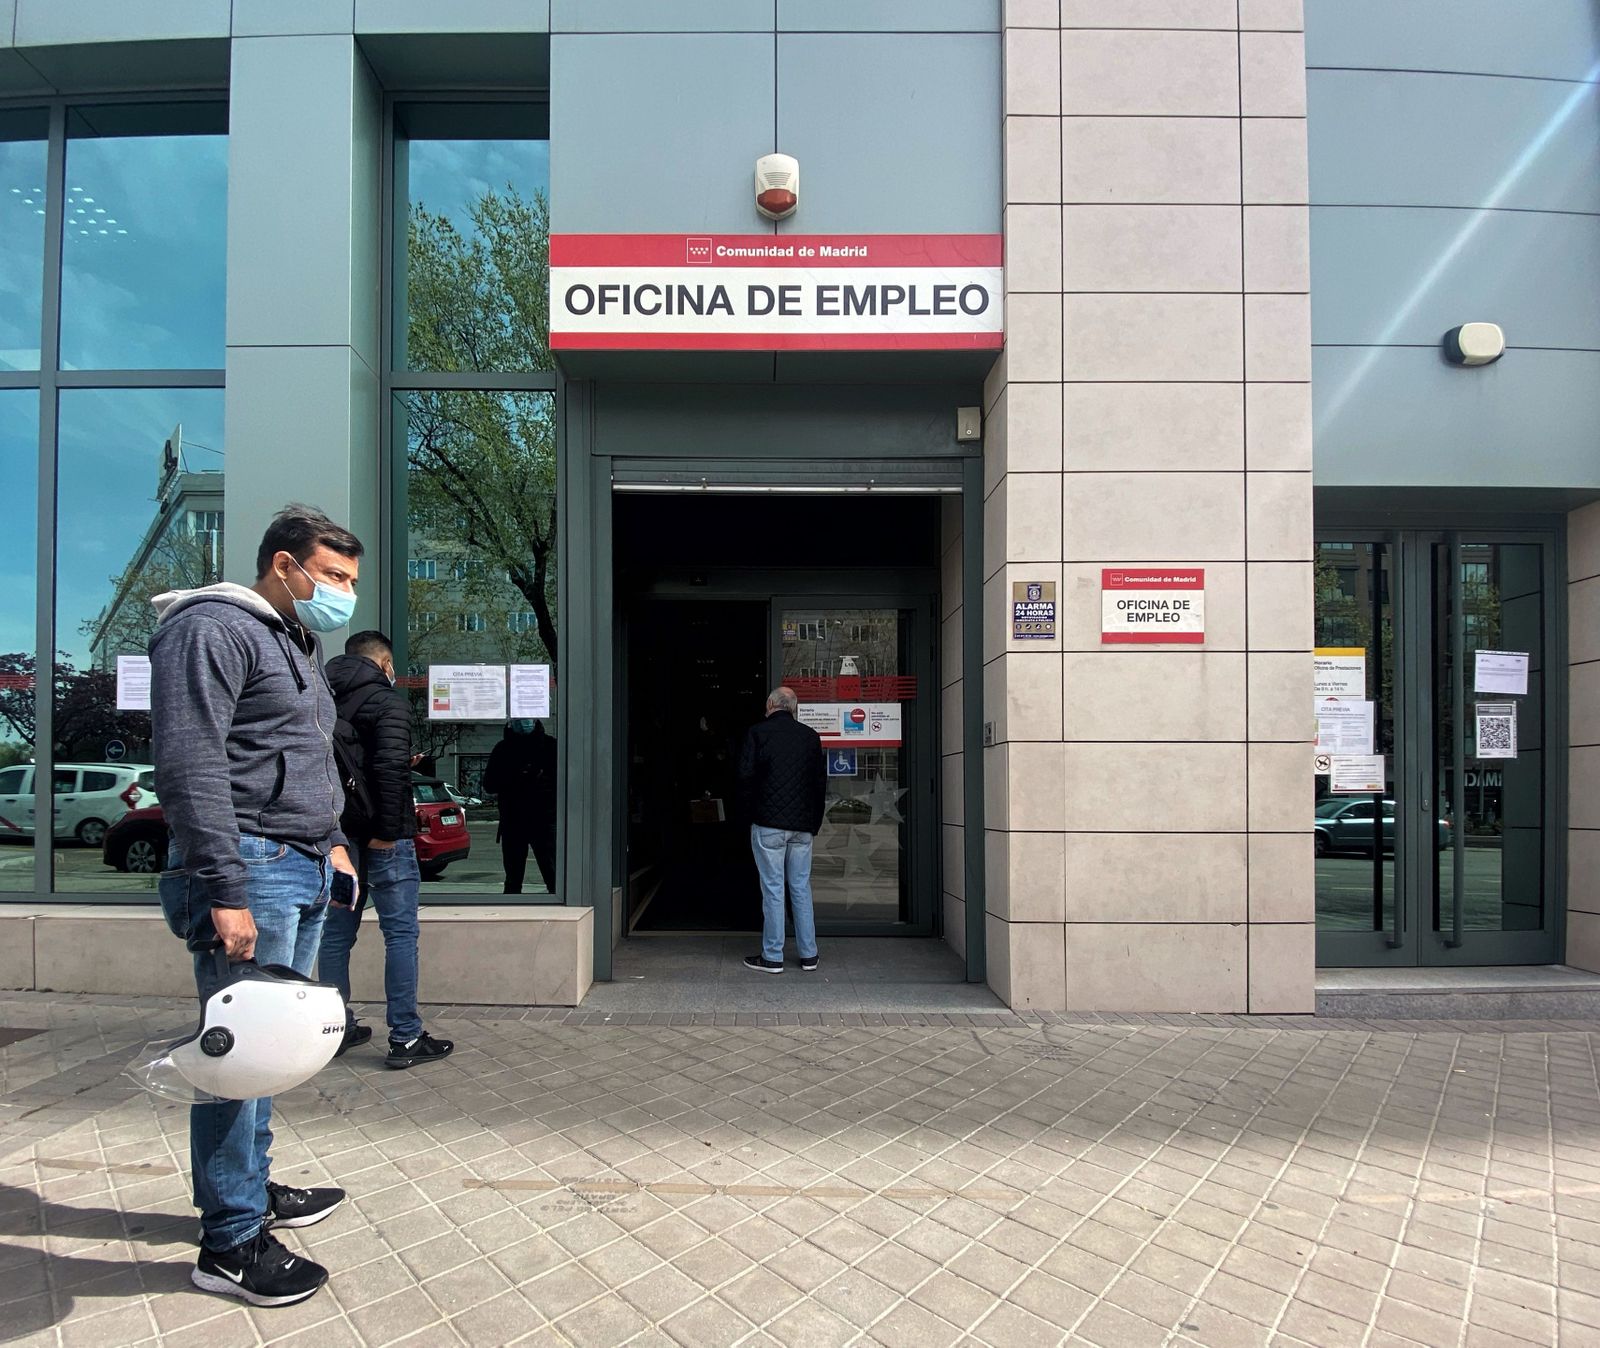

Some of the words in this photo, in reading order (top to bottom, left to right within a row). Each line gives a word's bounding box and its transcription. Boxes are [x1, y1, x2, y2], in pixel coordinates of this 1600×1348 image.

[716, 245, 794, 257] Comunidad
[798, 245, 815, 257] de
[819, 245, 868, 257] Madrid
[564, 283, 735, 316] OFICINA
[747, 284, 802, 316] DE
[816, 283, 990, 316] EMPLEO
[1116, 599, 1169, 610] OFICINA
[1172, 599, 1190, 610] DE
[1126, 612, 1181, 623] EMPLEO
